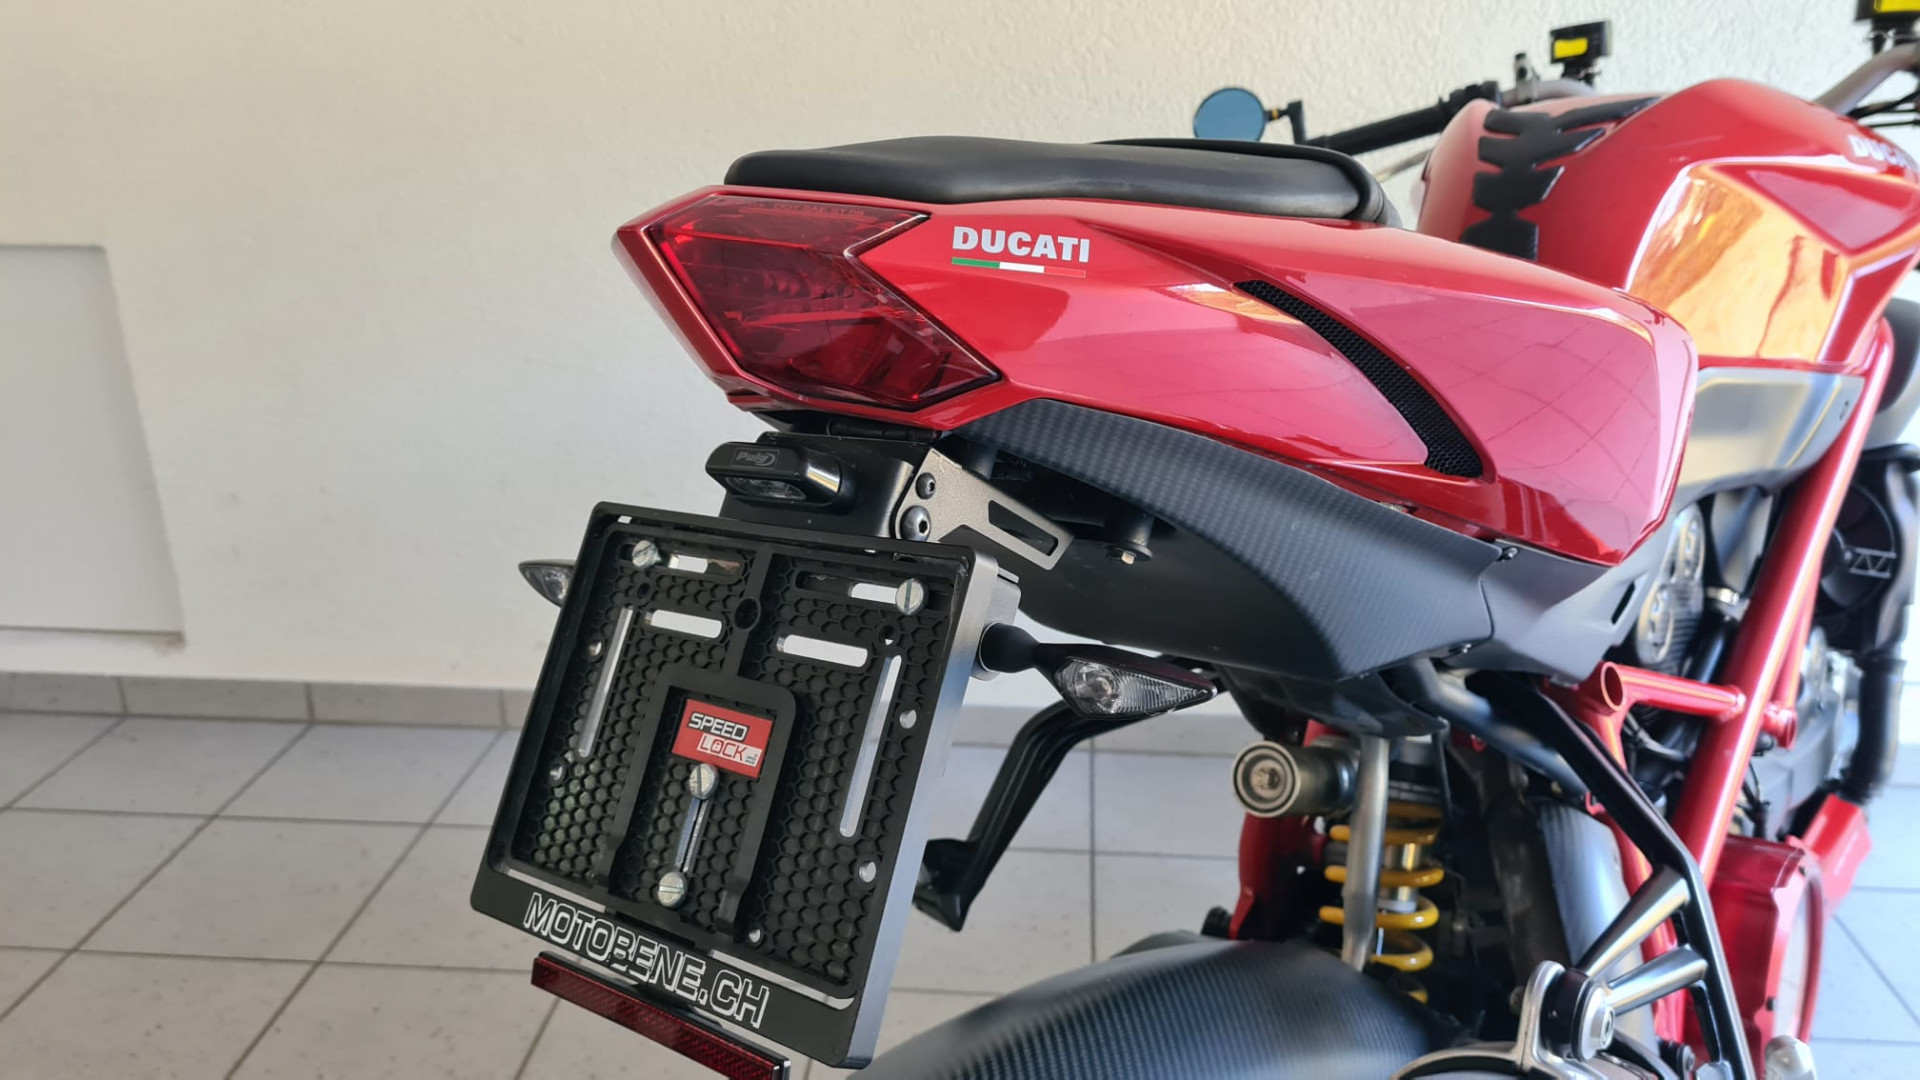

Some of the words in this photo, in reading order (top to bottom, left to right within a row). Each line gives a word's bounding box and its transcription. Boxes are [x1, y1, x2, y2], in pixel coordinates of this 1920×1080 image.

[952, 226, 1090, 263] DUCATI
[736, 451, 775, 466] Puig
[688, 712, 748, 742] SPEED
[700, 735, 747, 761] LOCK
[523, 892, 769, 1028] MOTOBENE.CH
